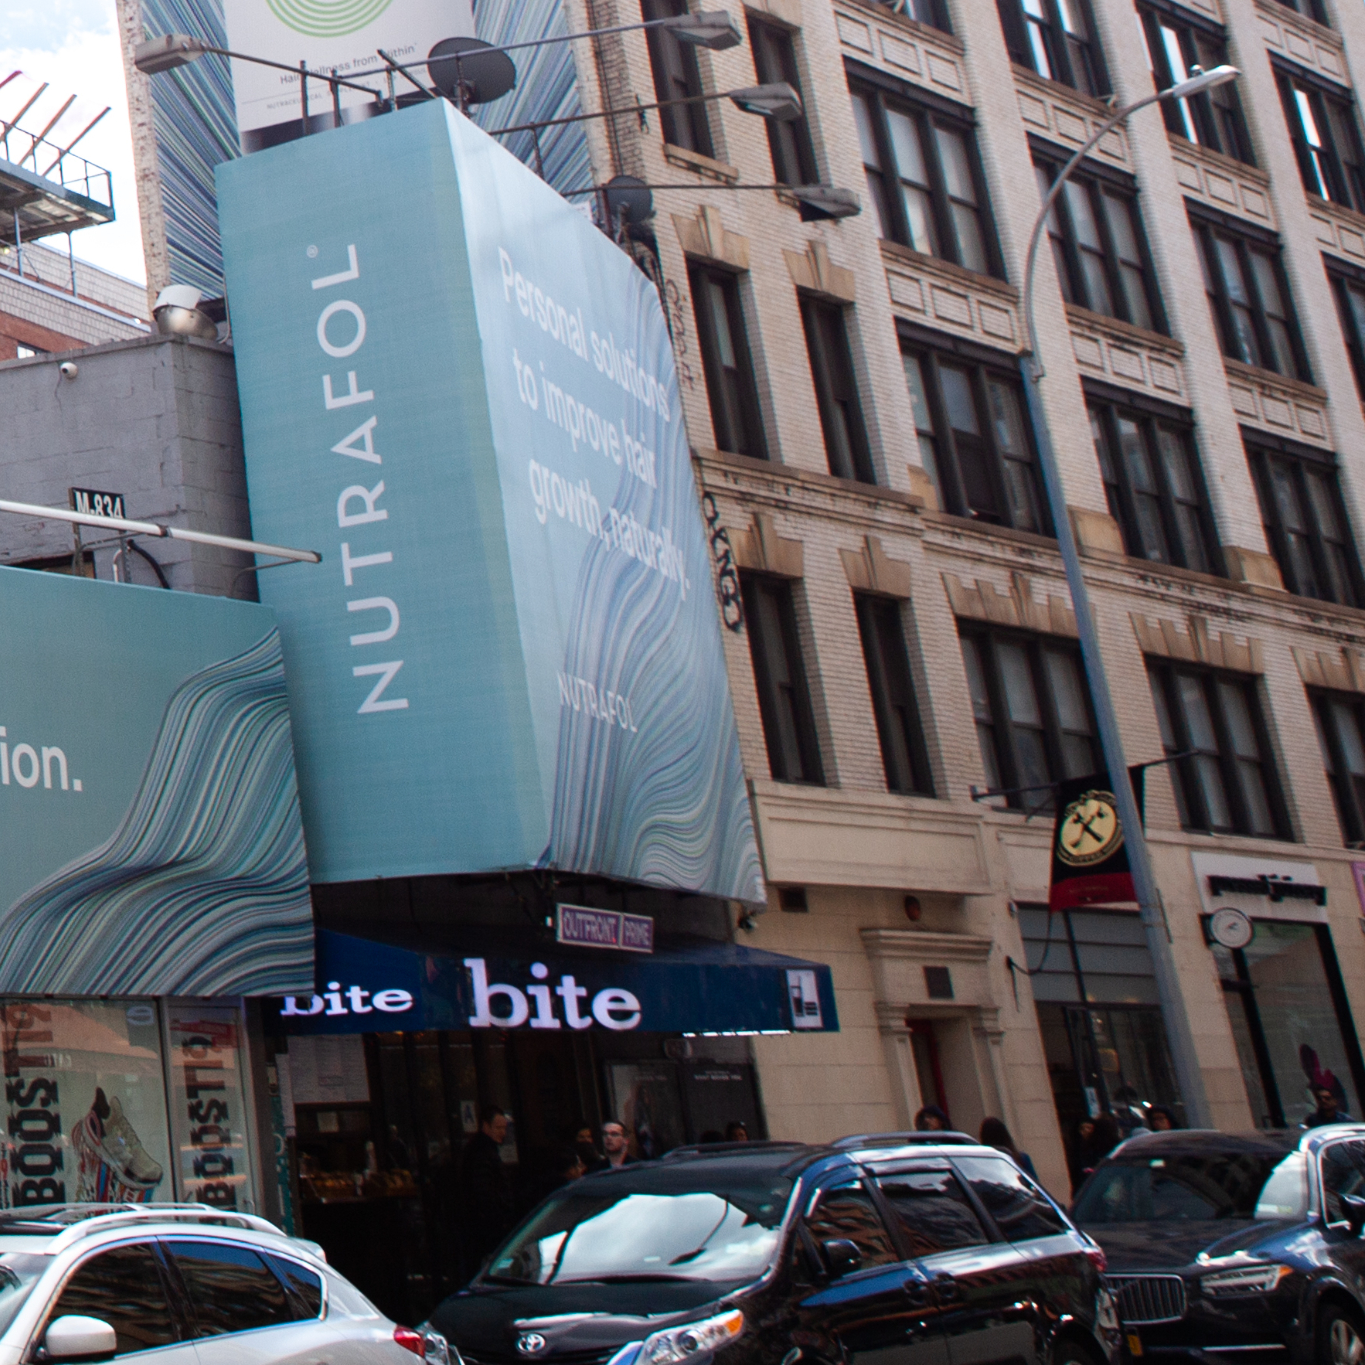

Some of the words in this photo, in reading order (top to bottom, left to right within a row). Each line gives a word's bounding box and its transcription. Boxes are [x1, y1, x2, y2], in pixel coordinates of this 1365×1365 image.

[353, 54, 378, 68] from
[381, 45, 415, 61] ithin
[498, 245, 589, 362] Personal
[590, 330, 671, 422] solutions
[512, 347, 538, 412] to
[539, 360, 622, 465] improve
[620, 418, 657, 489] hair
[75, 491, 124, 519] M-834
[311, 243, 409, 715] NUTRAFOL
[528, 458, 610, 552] growth,
[608, 505, 691, 602] naturally.
[557, 670, 638, 733] NUTRAFOL
[463, 957, 642, 1030] bite
